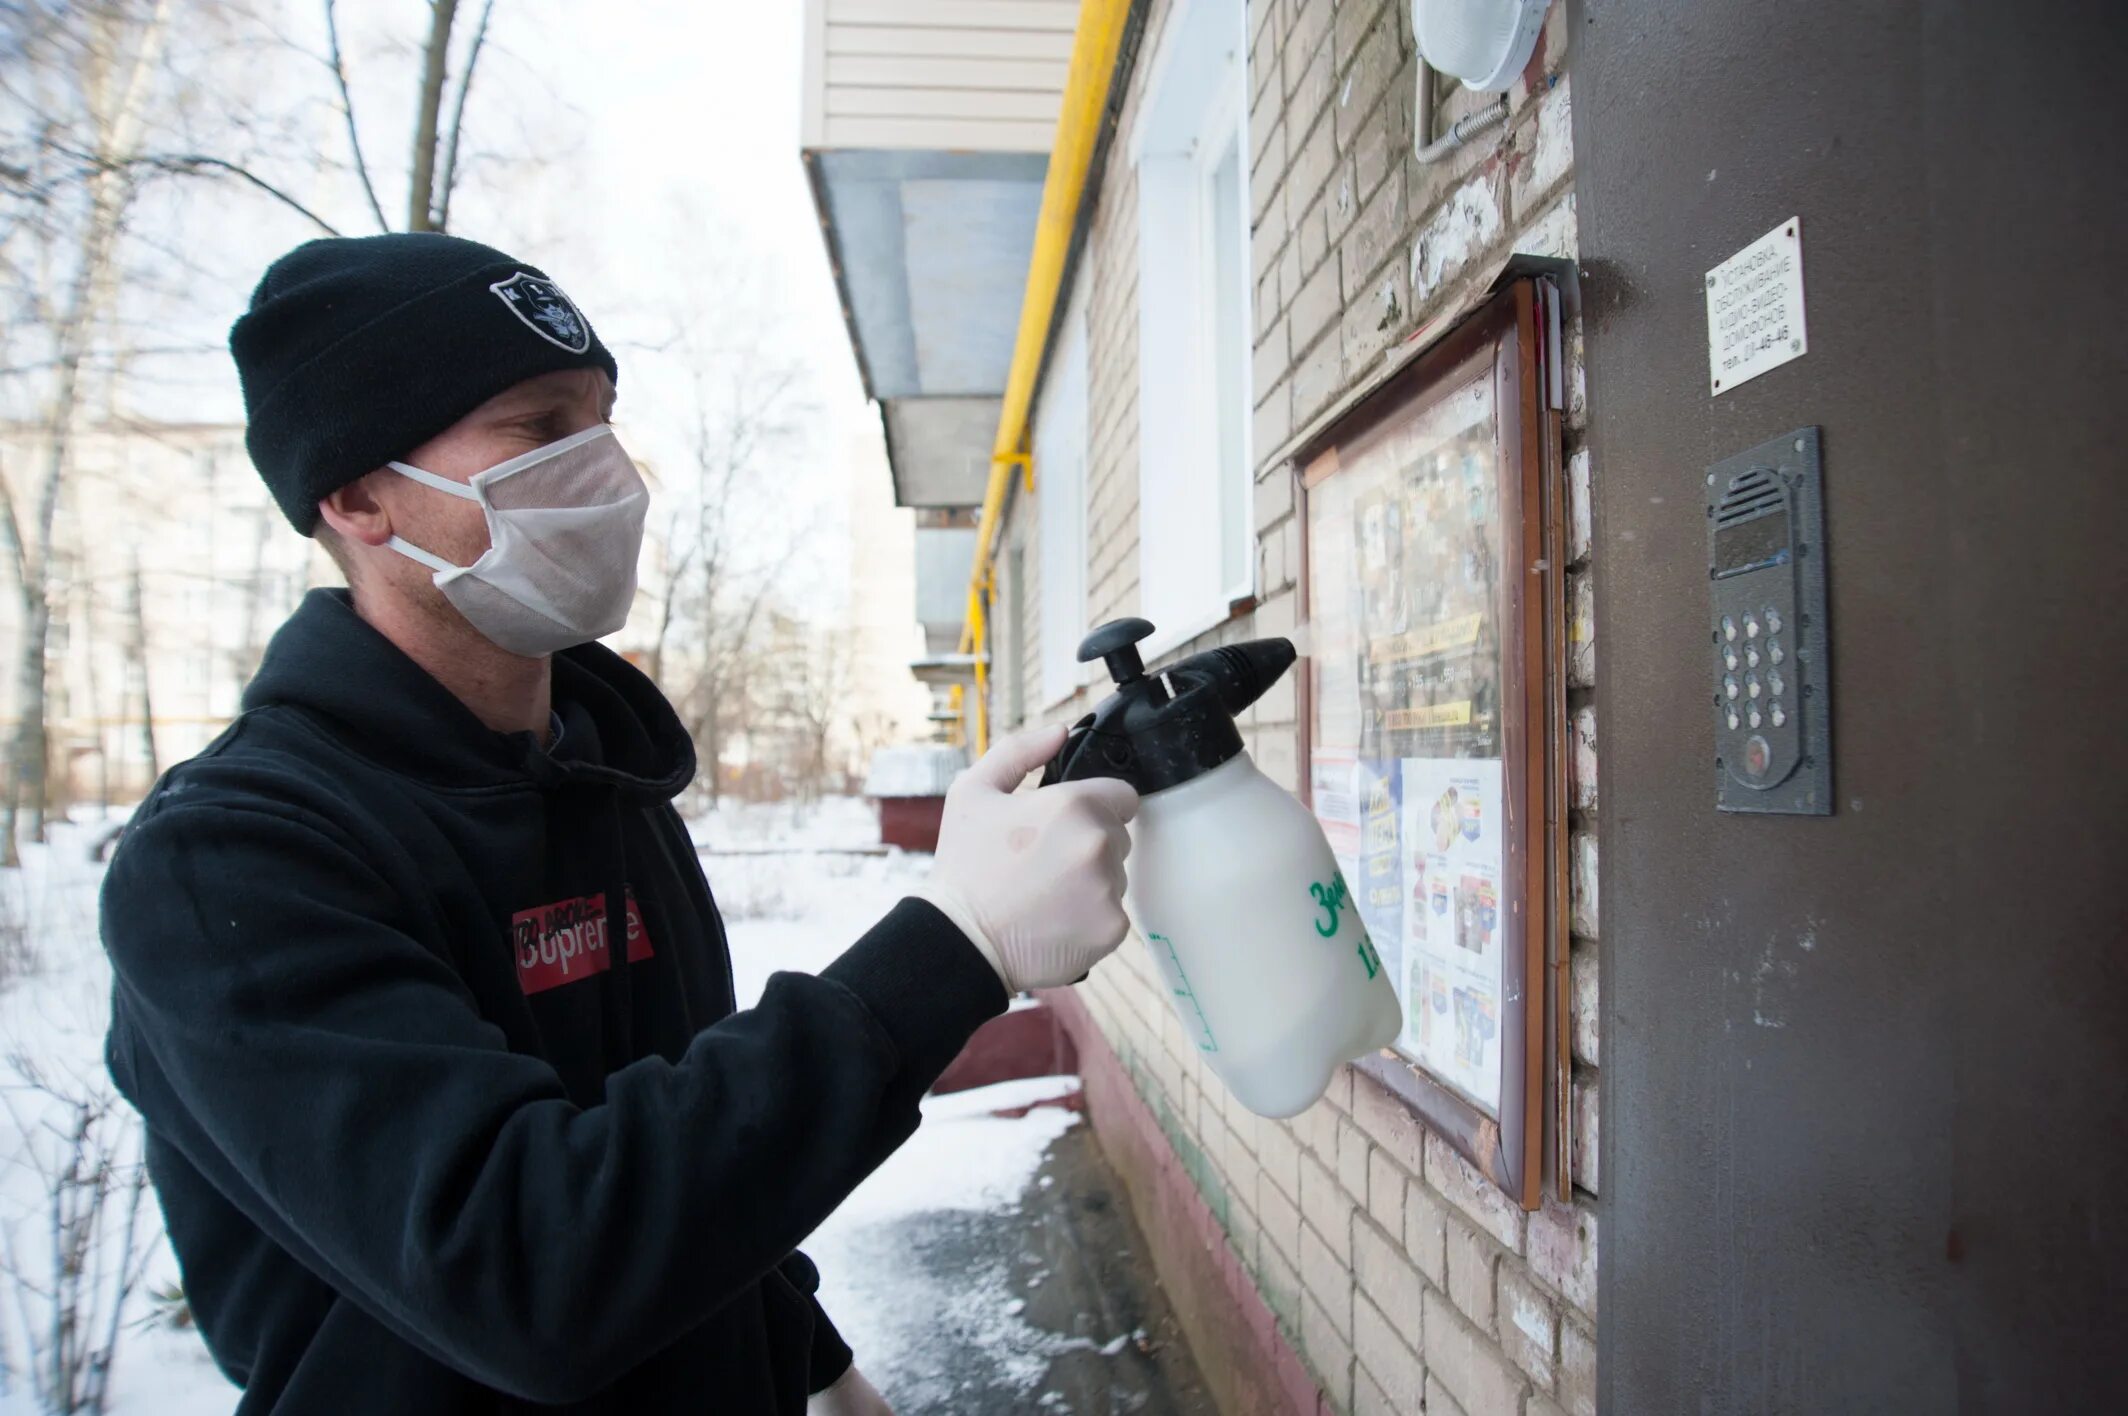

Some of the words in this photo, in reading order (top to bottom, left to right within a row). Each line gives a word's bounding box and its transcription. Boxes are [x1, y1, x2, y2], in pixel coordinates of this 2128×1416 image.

[1715, 255, 1791, 315] ОБСЛУЖИВАНИЕ
[1723, 304, 1785, 351] ДОМОФОНОВ
[518, 911, 641, 975] Supree
